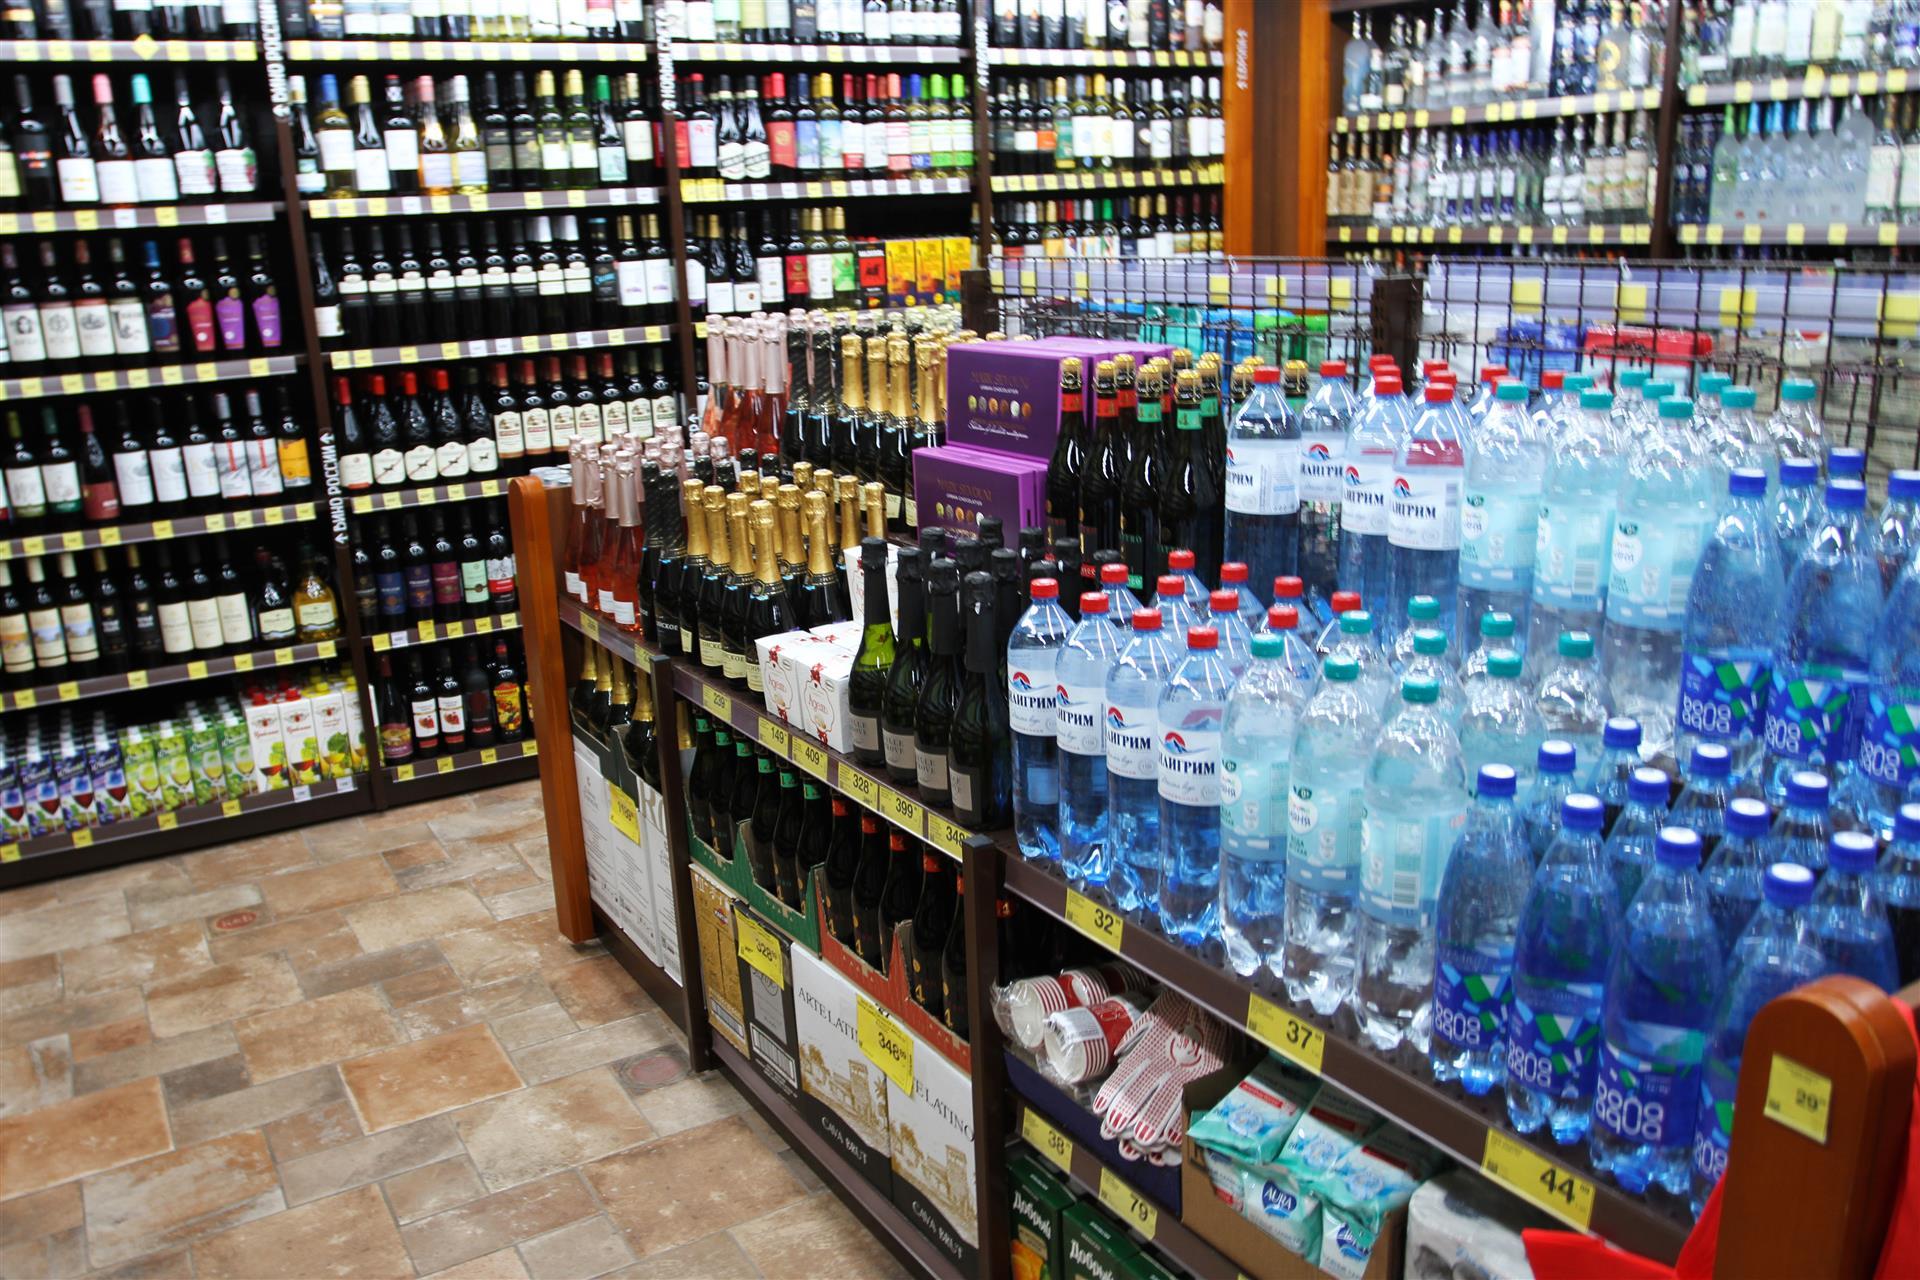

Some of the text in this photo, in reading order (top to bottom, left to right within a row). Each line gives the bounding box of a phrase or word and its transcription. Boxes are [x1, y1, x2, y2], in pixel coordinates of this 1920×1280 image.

[267, 63, 288, 102] ВИНО
[321, 445, 348, 532] ВИНО РОССИИ
[771, 727, 784, 744] 149
[806, 747, 820, 765] 409
[853, 773, 869, 794] 328
[896, 798, 913, 819] 399
[1095, 908, 1113, 936] 32
[756, 938, 772, 962] 328
[828, 1010, 858, 1043] LATI
[1287, 1019, 1312, 1049] 37
[878, 1032, 900, 1061] 348
[821, 1116, 843, 1144] CAVA
[1048, 1130, 1064, 1155] 38
[1264, 1186, 1292, 1211] AURA
[1540, 1168, 1575, 1204] 44
[912, 1201, 936, 1233] CAVA
[1013, 1191, 1051, 1240] Добрый
[1130, 1191, 1148, 1222] 79
